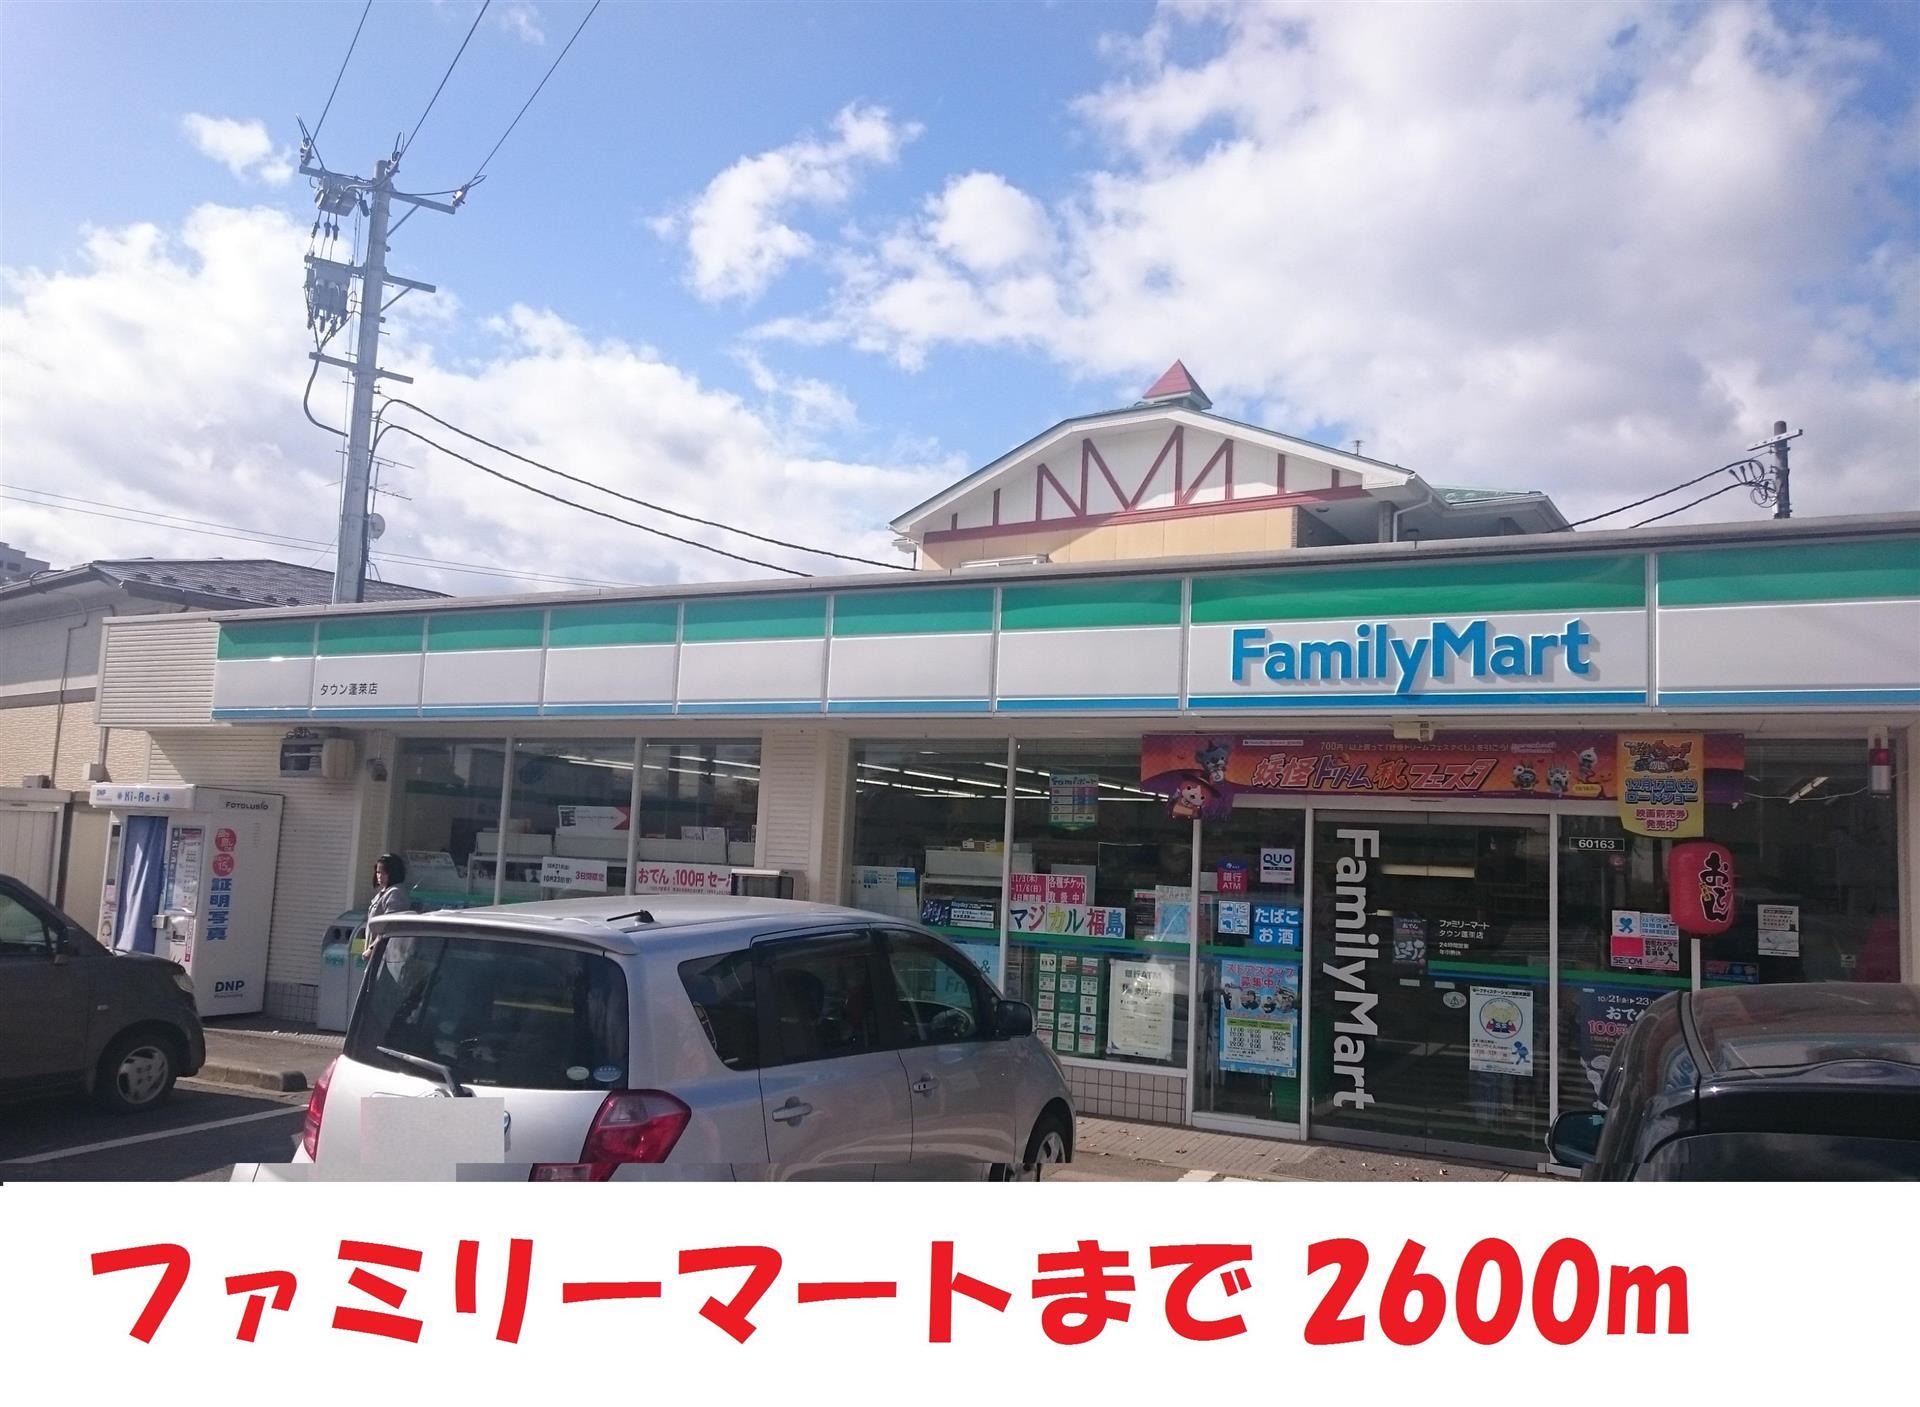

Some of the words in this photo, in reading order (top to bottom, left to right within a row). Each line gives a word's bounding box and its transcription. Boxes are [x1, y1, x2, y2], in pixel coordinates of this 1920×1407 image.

[1231, 617, 1592, 695] FamilyMart
[1625, 791, 1698, 806] ロードショー
[1635, 807, 1688, 820] 映画前売券
[1645, 819, 1678, 831] 発売中
[1577, 838, 1616, 850] 60163
[1263, 853, 1293, 867] QUO
[638, 867, 670, 886] おでん
[1048, 876, 1085, 889] 各種チケット
[1223, 872, 1242, 883] 銀行
[1222, 882, 1241, 891] ATM
[1699, 851, 1734, 923] おでん
[206, 877, 233, 941] 証明写真
[1009, 904, 1125, 938] マジカル福島
[1255, 908, 1299, 925] たばこ
[1438, 919, 1491, 931] ファミリーマート
[1258, 928, 1295, 945] お酒
[1613, 956, 1644, 966] SECOM
[1225, 963, 1296, 979] ストアスタッフ
[1323, 828, 1381, 1110] FamilyMart
[214, 979, 246, 993] DNP
